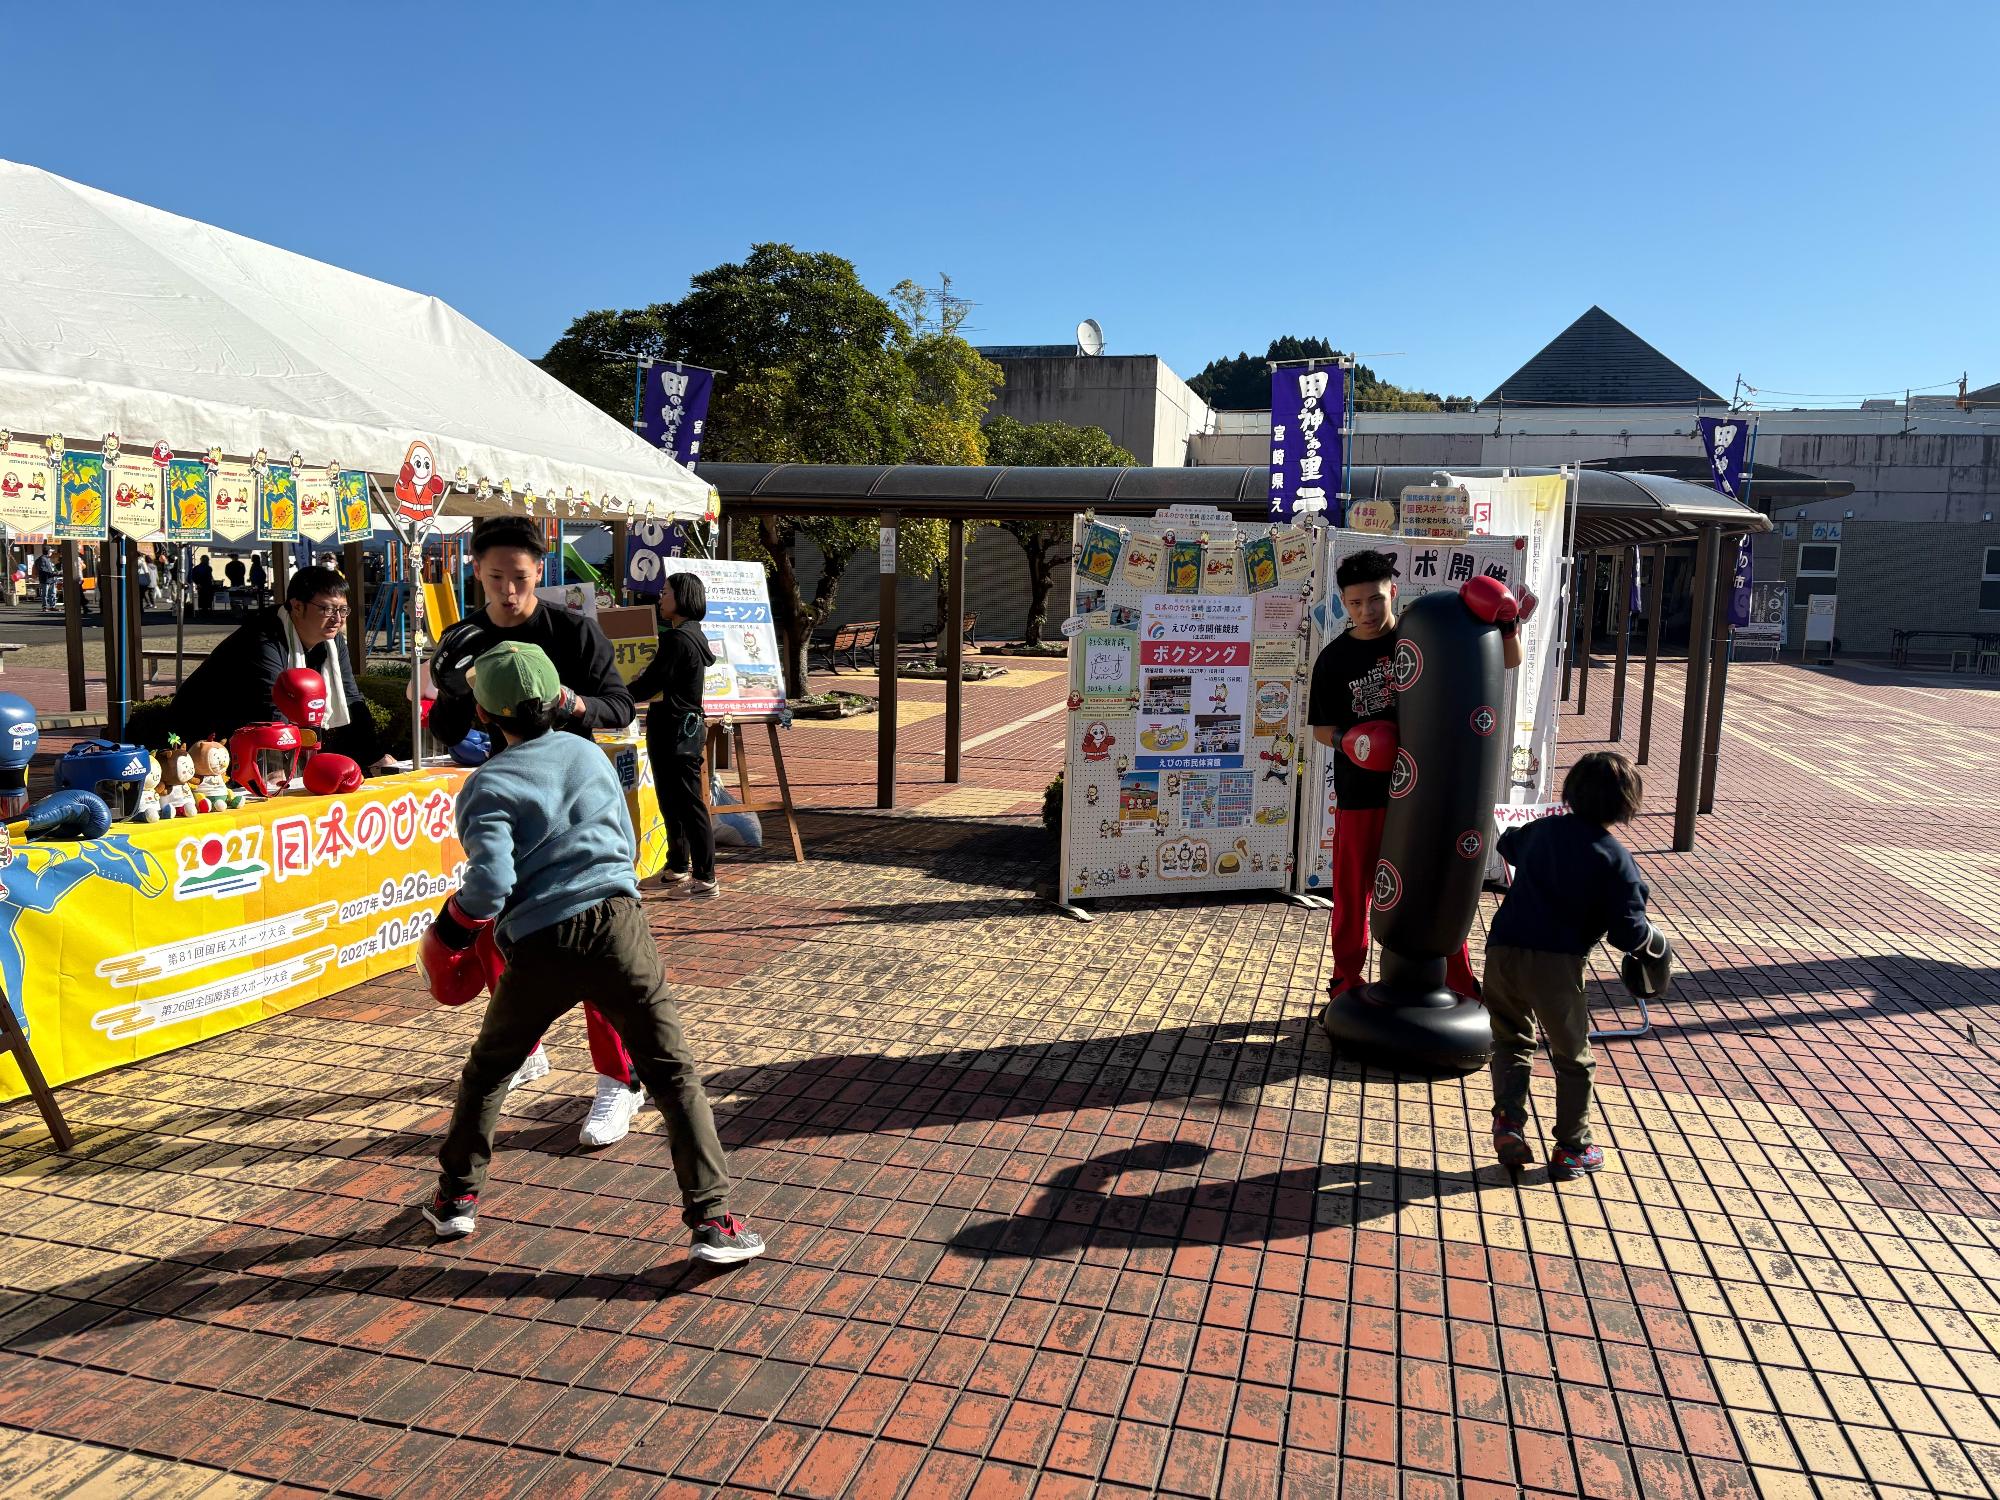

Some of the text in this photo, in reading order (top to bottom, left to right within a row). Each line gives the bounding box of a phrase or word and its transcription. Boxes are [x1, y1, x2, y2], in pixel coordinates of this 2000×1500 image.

[1814, 526, 1840, 537] かん
[708, 605, 766, 621] ーキング
[1171, 624, 1240, 634] えびの市開催競技
[616, 643, 657, 664] 打ち
[1153, 645, 1237, 663] ボクシング
[1159, 758, 1222, 768] えびの市民体育館
[121, 767, 147, 777] adidas
[276, 793, 451, 877] 日本のひな
[168, 924, 287, 966] 第81回国民スポーツ大会
[161, 969, 289, 1017] 第26回全国障害者スポーツ大会
